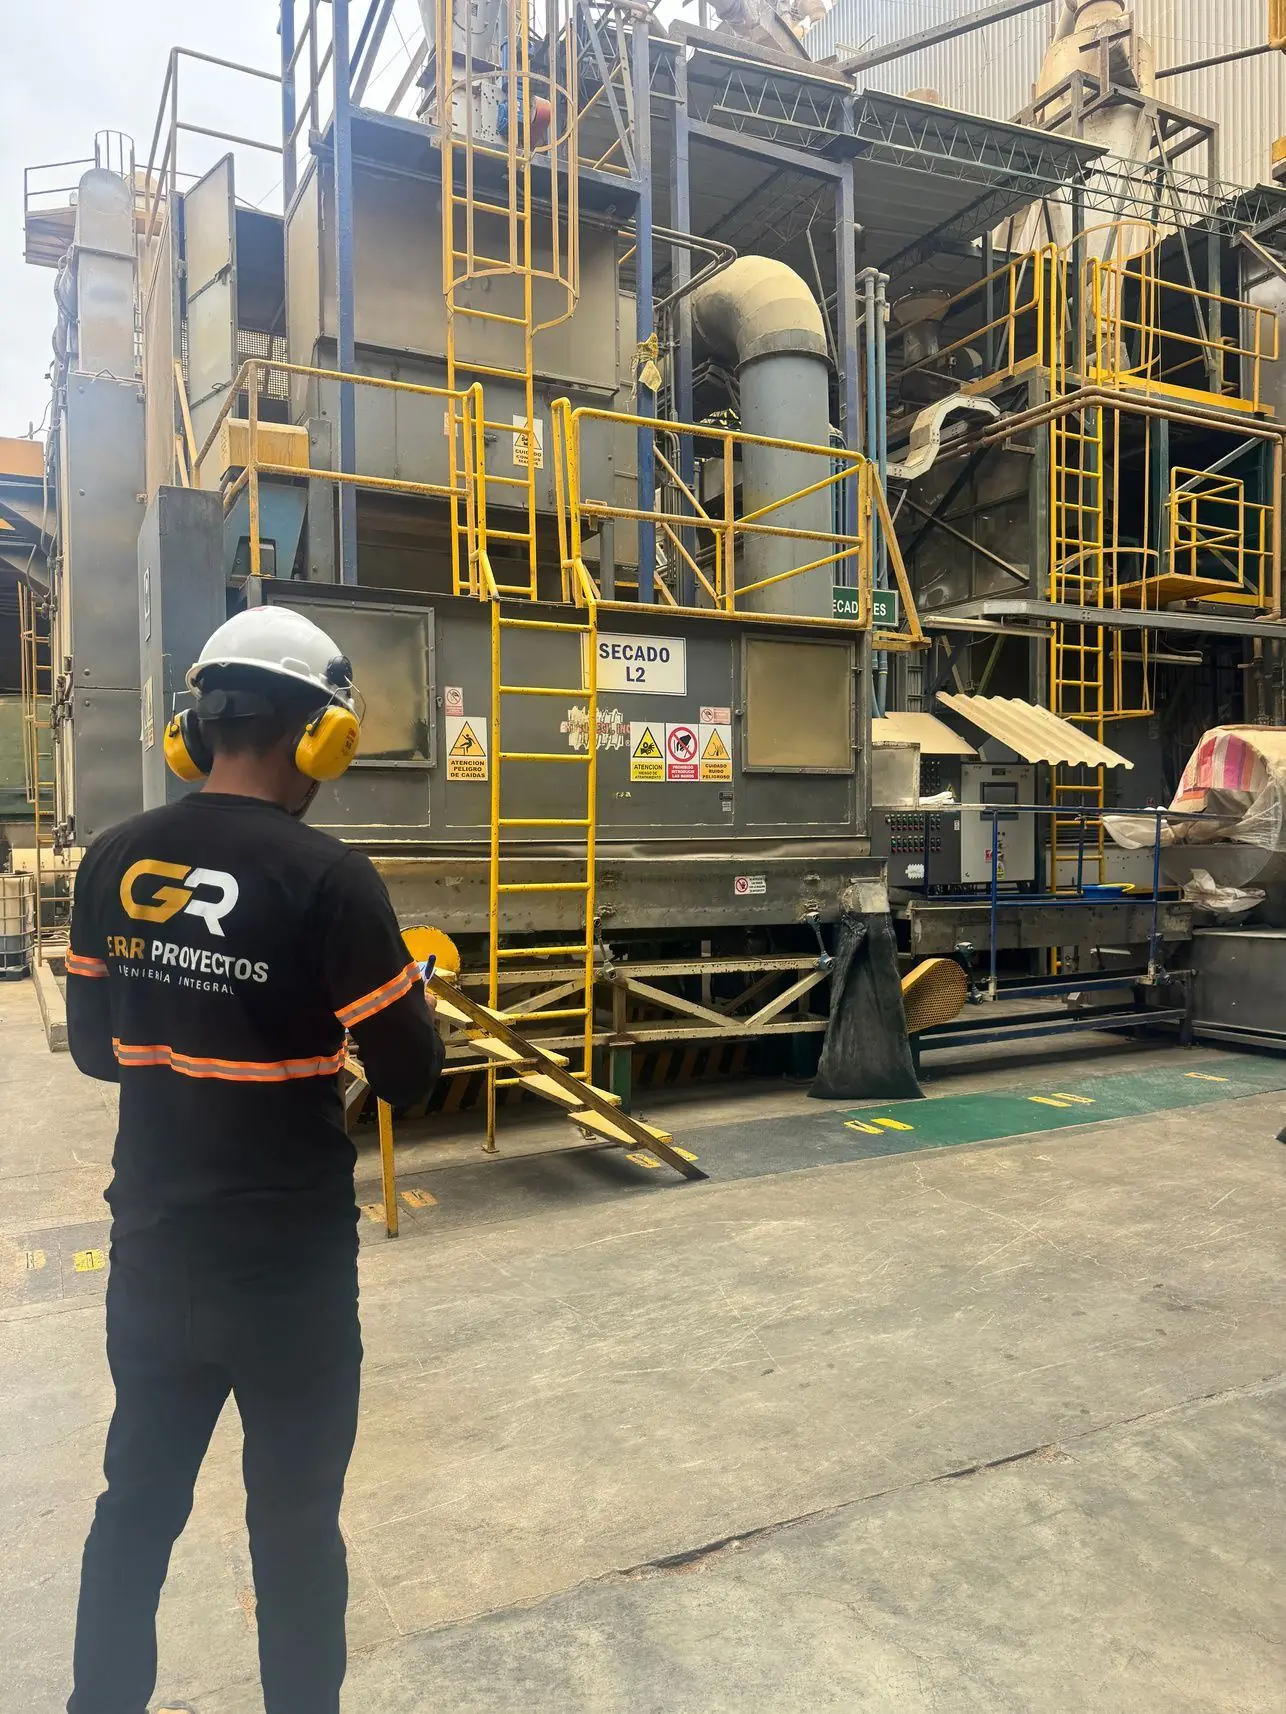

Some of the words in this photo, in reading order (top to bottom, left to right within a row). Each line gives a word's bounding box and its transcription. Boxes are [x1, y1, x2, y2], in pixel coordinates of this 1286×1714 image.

[599, 643, 670, 663] SECADO
[626, 666, 646, 682] L2
[119, 858, 240, 937] GR
[151, 939, 269, 983] PROYECTOS
[178, 975, 235, 995] INTEGRAL
